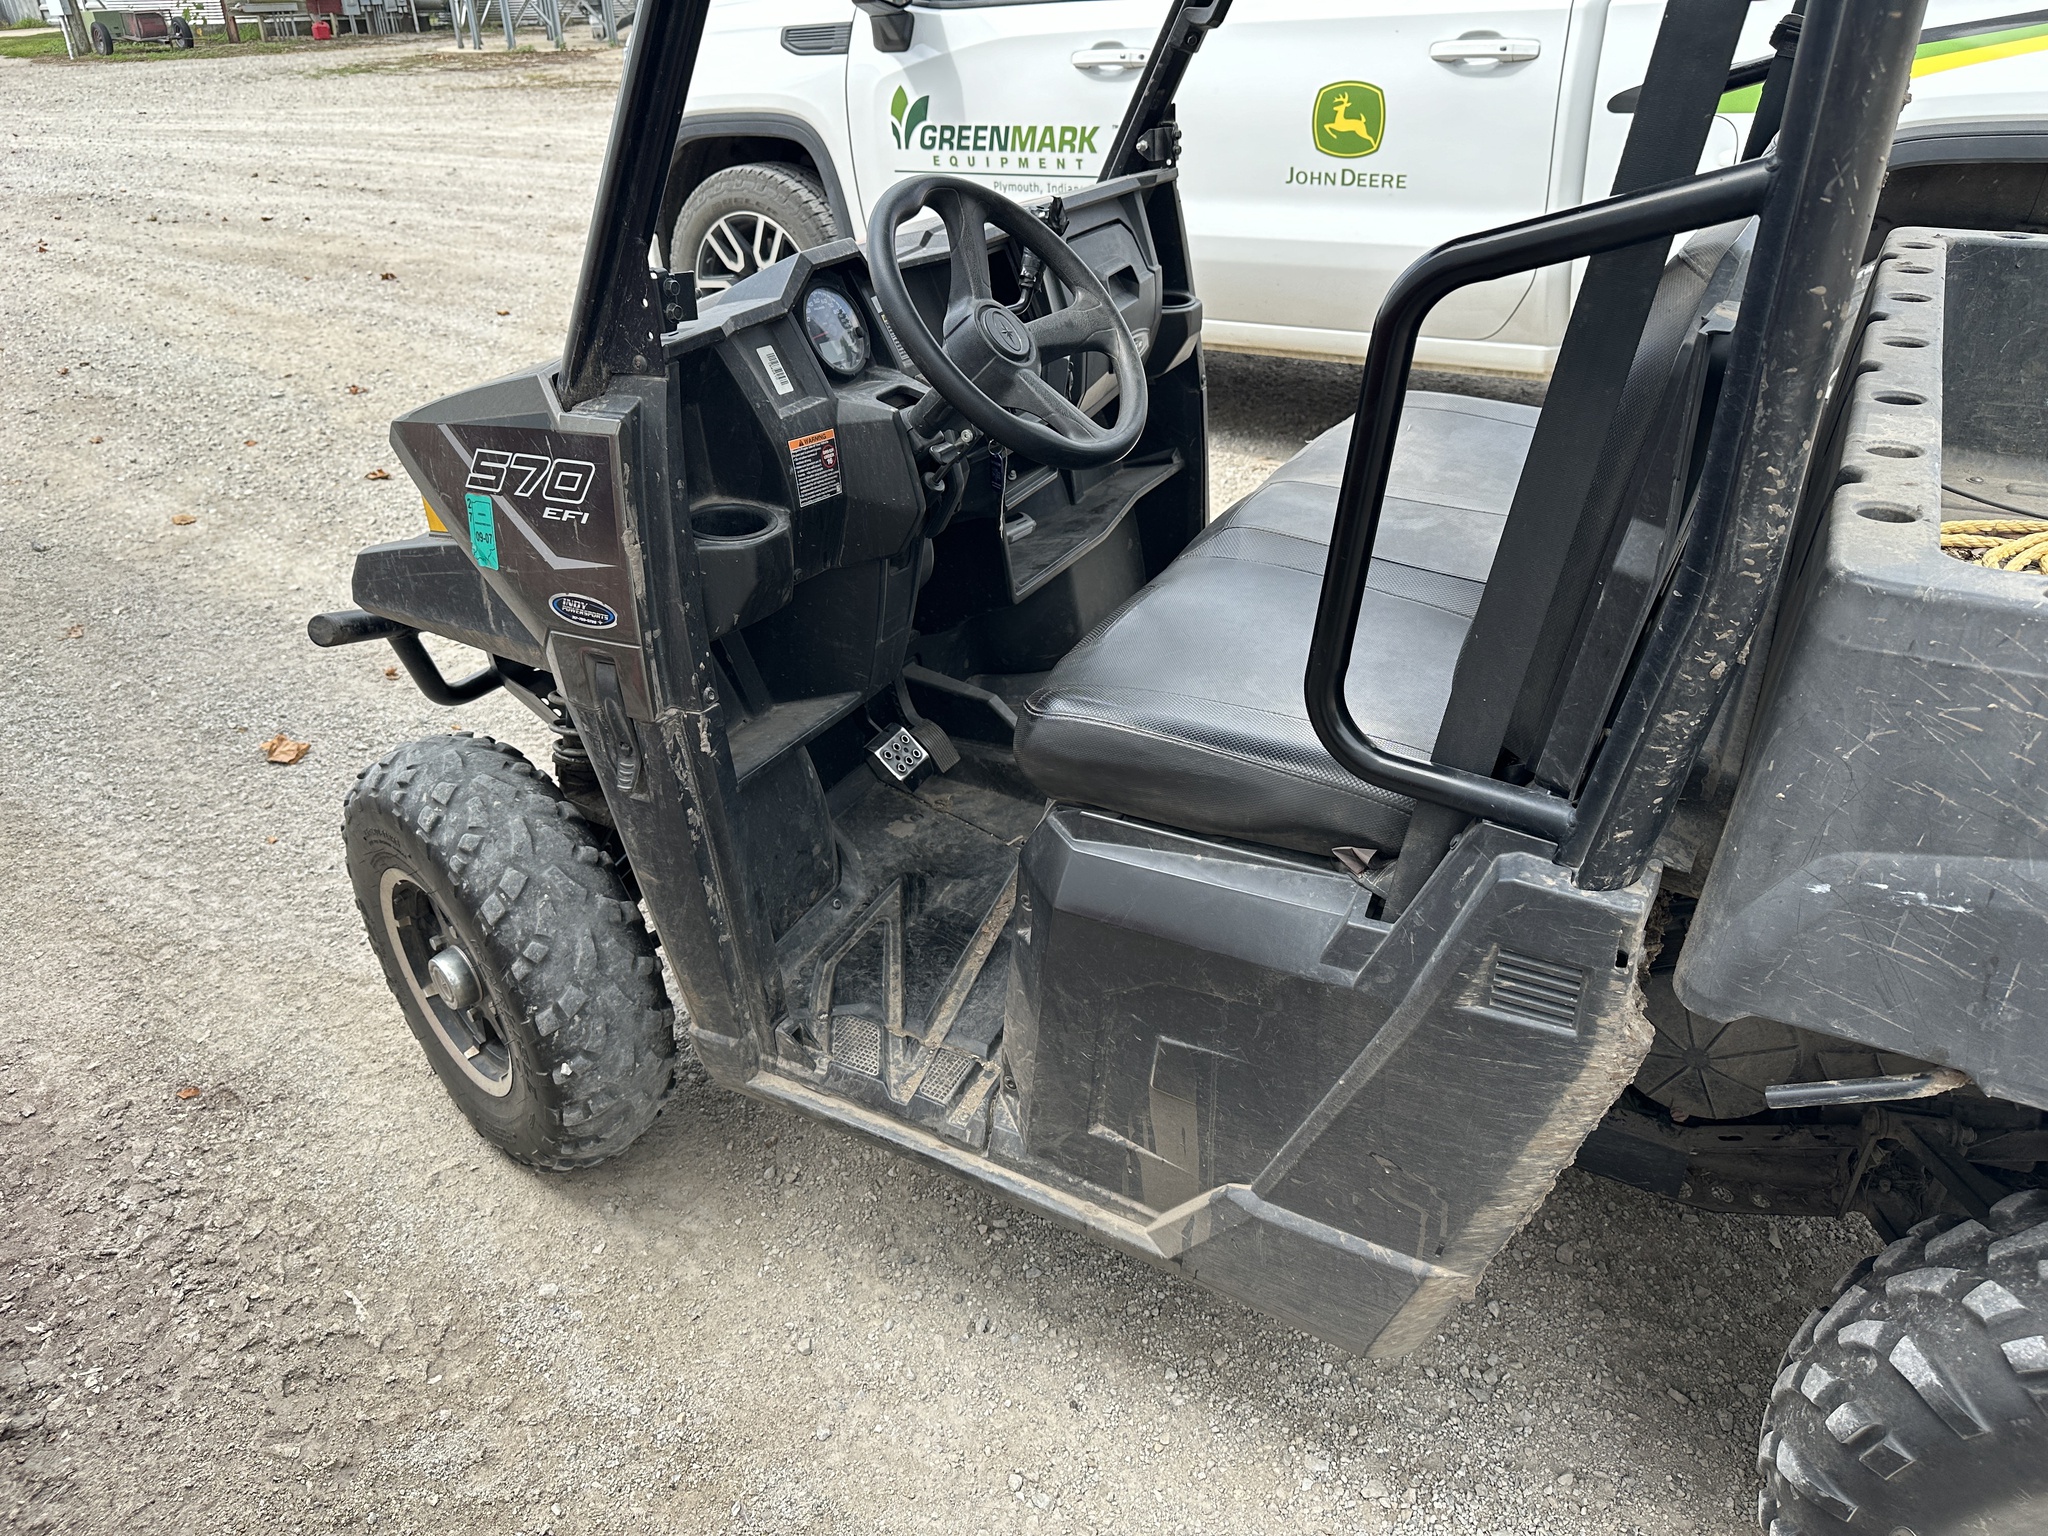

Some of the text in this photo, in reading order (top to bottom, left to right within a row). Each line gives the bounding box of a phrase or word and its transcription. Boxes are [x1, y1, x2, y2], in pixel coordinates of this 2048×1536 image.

[919, 124, 1100, 154] GREENMARK
[933, 155, 1083, 170] EQUIPMENT
[993, 181, 1083, 194] Plymouth, Indian
[465, 448, 596, 504] 570
[542, 506, 590, 525] EFI
[475, 531, 493, 544] 09-07
[562, 597, 588, 610] INDY
[561, 605, 610, 620] POWERSPORTS
